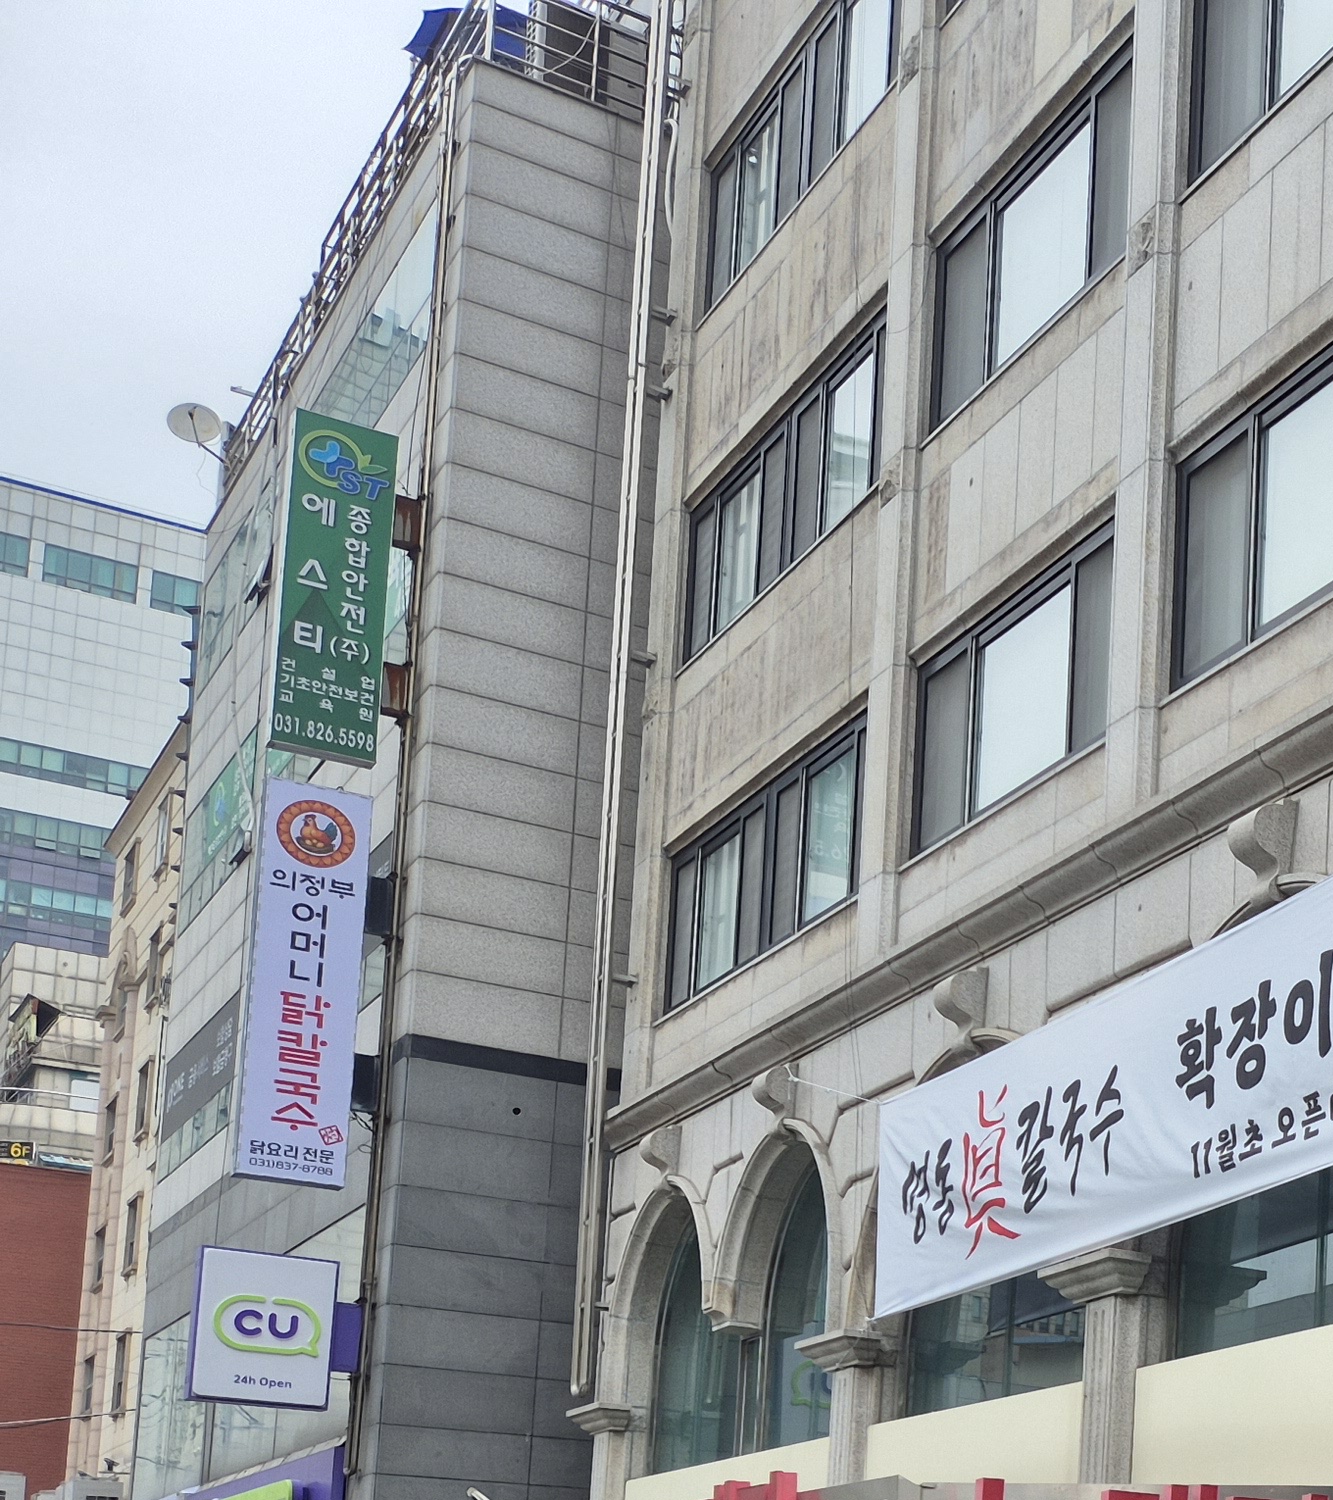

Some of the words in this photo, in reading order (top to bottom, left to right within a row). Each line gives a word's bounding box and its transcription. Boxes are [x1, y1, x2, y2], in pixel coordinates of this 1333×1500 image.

[274, 713, 374, 752] 031.826.5598
[269, 869, 355, 899] 의정부
[289, 902, 328, 987] 어머니
[271, 990, 331, 1131] 닭칼국수
[249, 1157, 333, 1176] 031)837-8788
[250, 1139, 298, 1160] 닭요리
[302, 1146, 335, 1165] 전문
[234, 1309, 299, 1339] CU
[234, 1375, 256, 1385] 24h
[259, 1377, 292, 1389] Open
